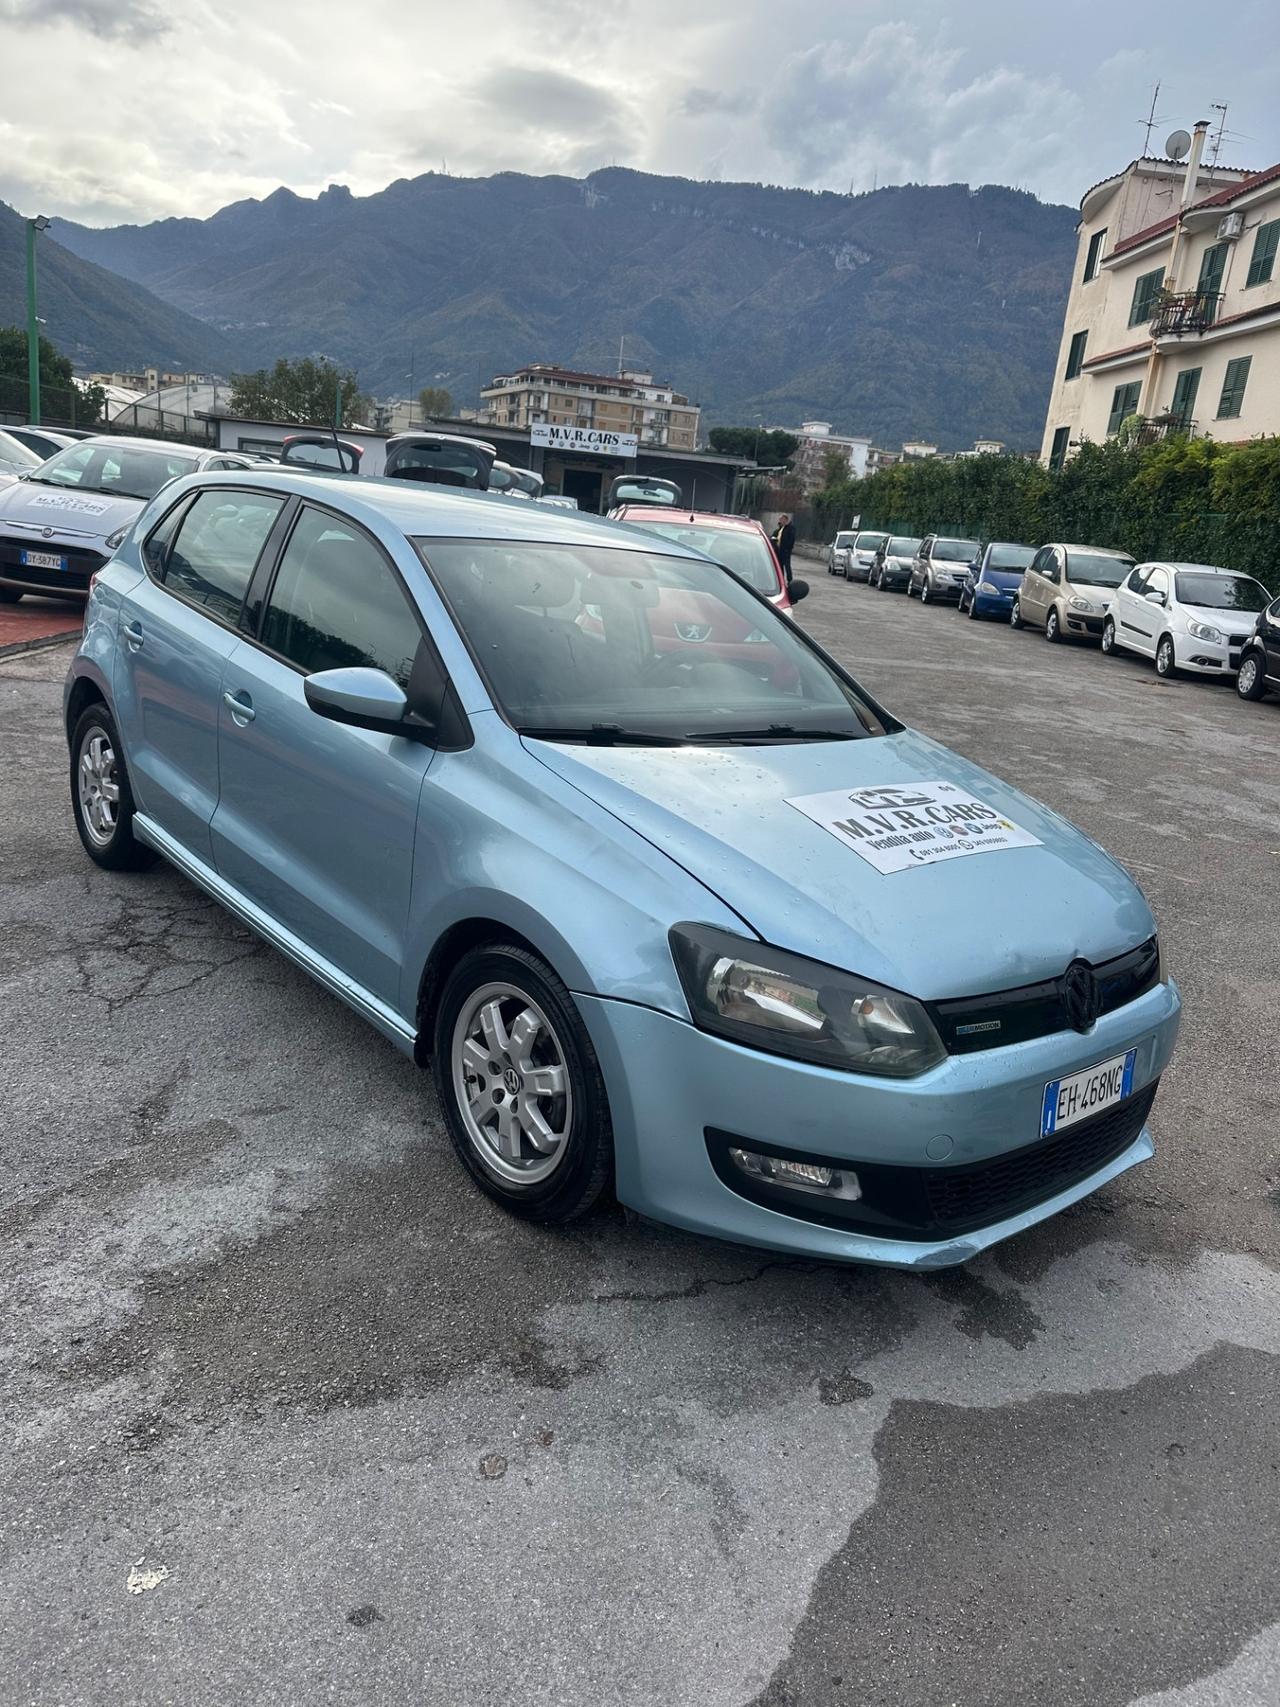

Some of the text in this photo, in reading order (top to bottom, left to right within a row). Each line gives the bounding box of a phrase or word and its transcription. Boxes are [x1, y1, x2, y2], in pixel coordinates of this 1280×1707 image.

[865, 830, 935, 850] Vendita auto
[959, 1022, 1000, 1033] MOTION
